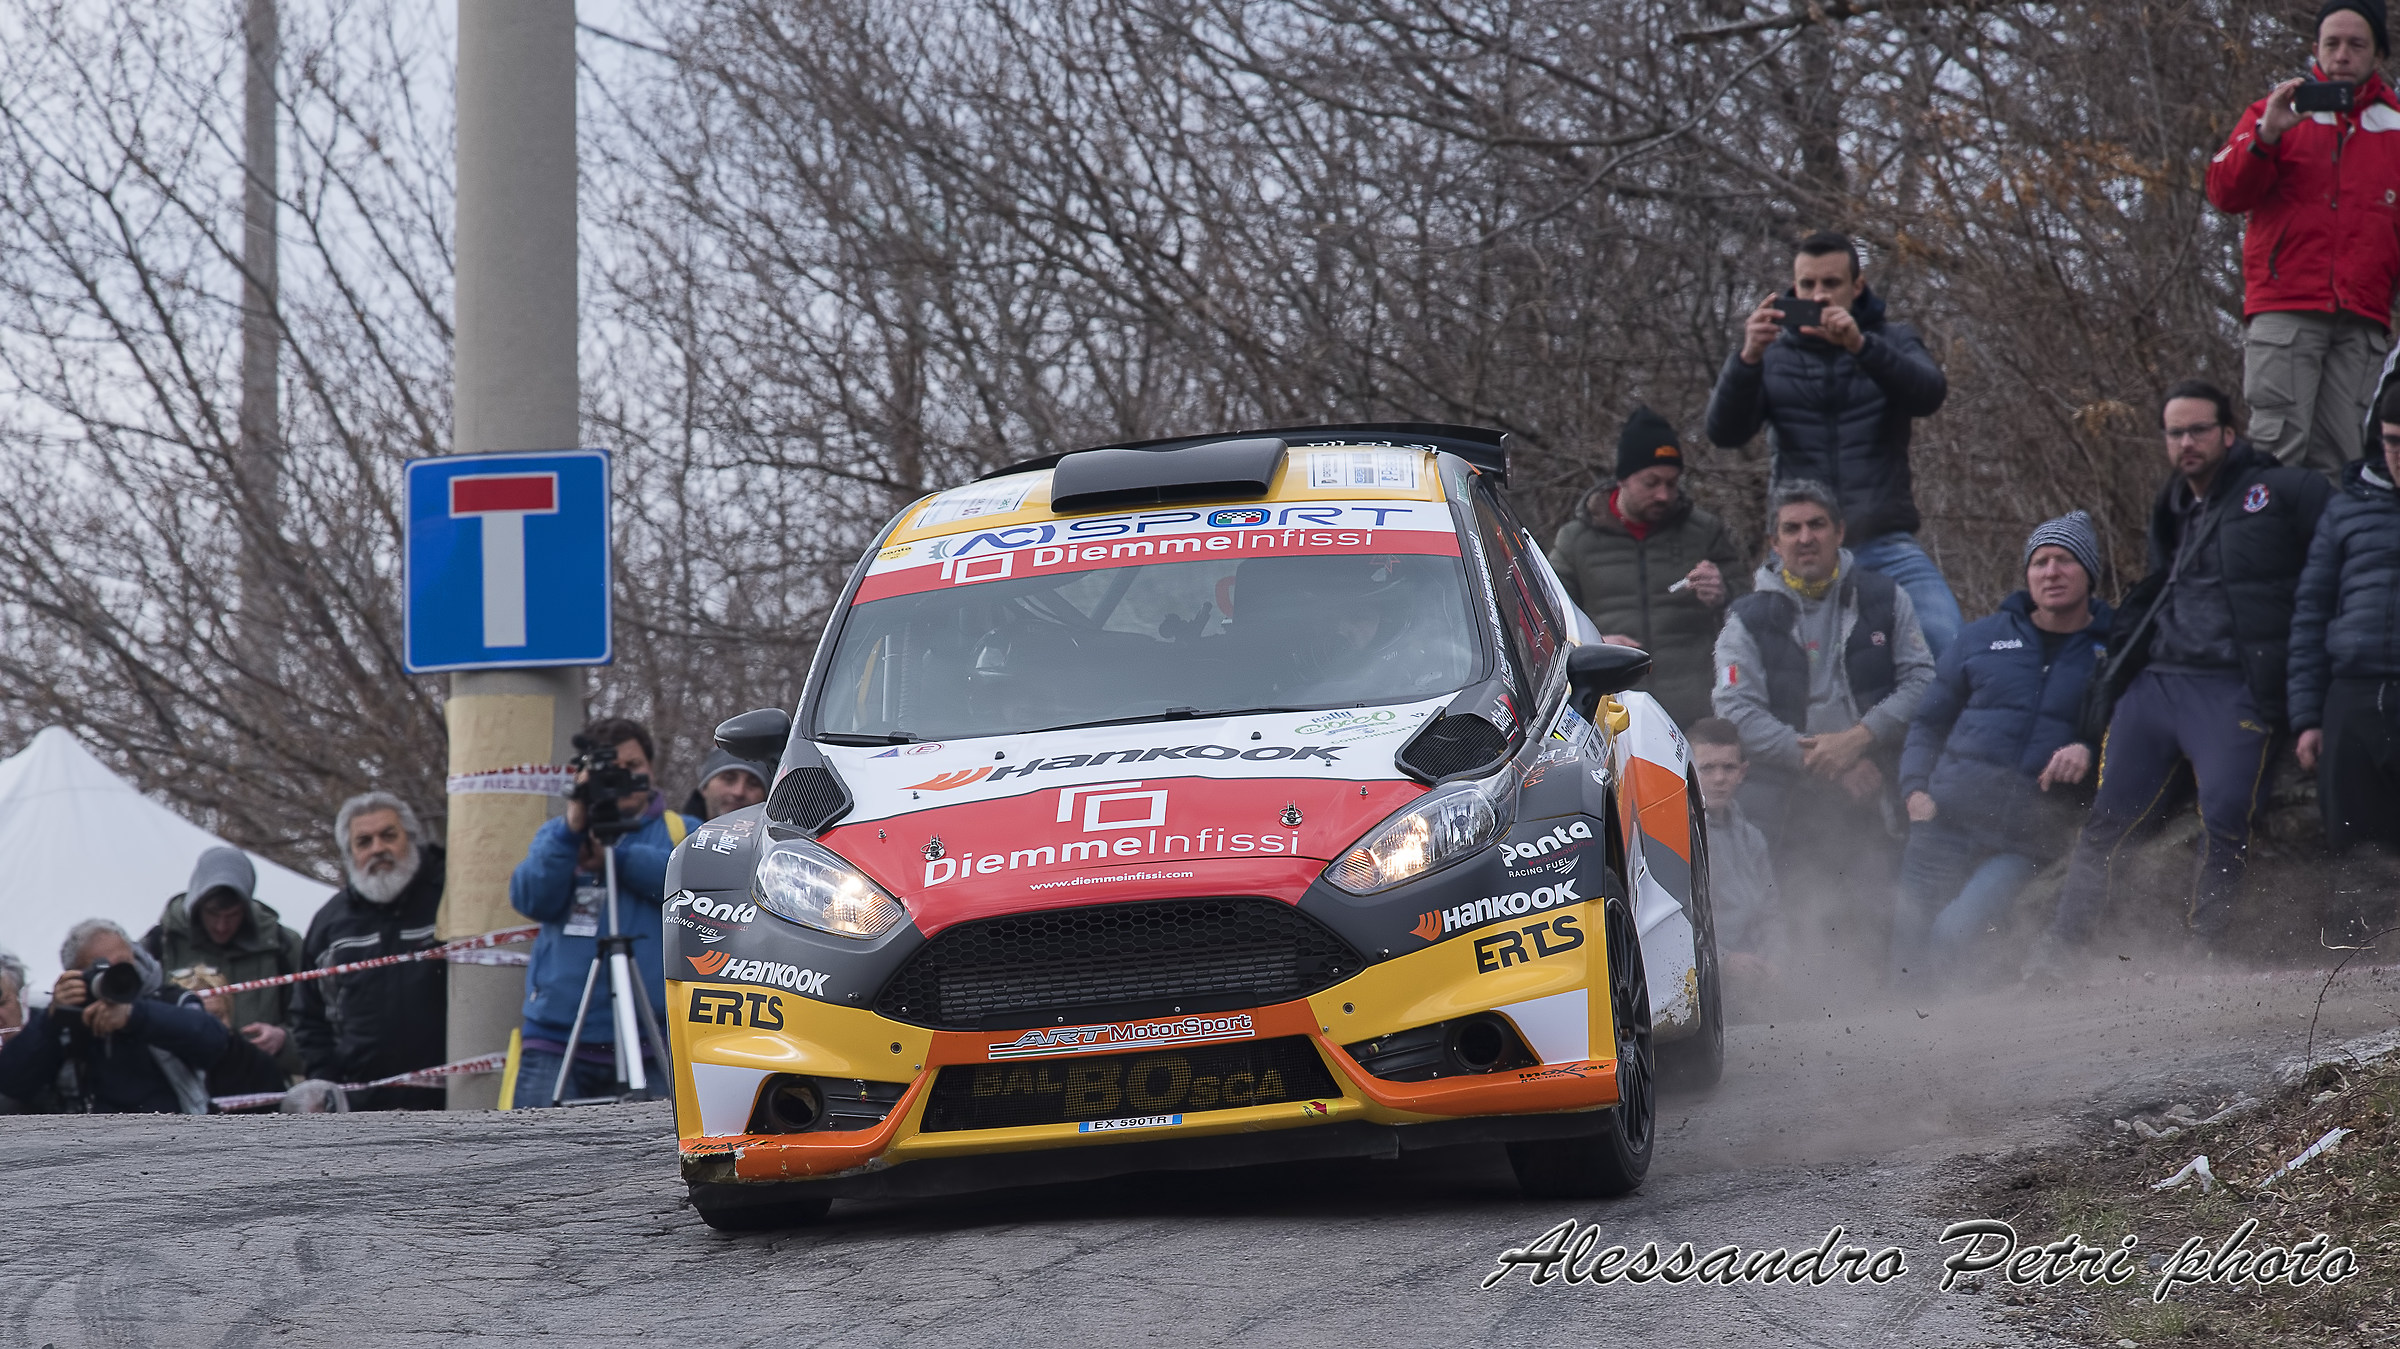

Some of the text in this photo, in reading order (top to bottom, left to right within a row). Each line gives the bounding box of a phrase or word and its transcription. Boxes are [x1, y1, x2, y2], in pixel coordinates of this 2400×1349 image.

[1508, 857, 1571, 878] RACING FUEL
[1030, 869, 1193, 891] www.diemmeinfissi.com
[664, 916, 719, 936] RACING FUEL
[1473, 915, 1585, 974] ERTS
[688, 987, 785, 1031] ERTS
[1015, 1025, 1108, 1047] ART
[1094, 1114, 1168, 1130] EX 590TR
